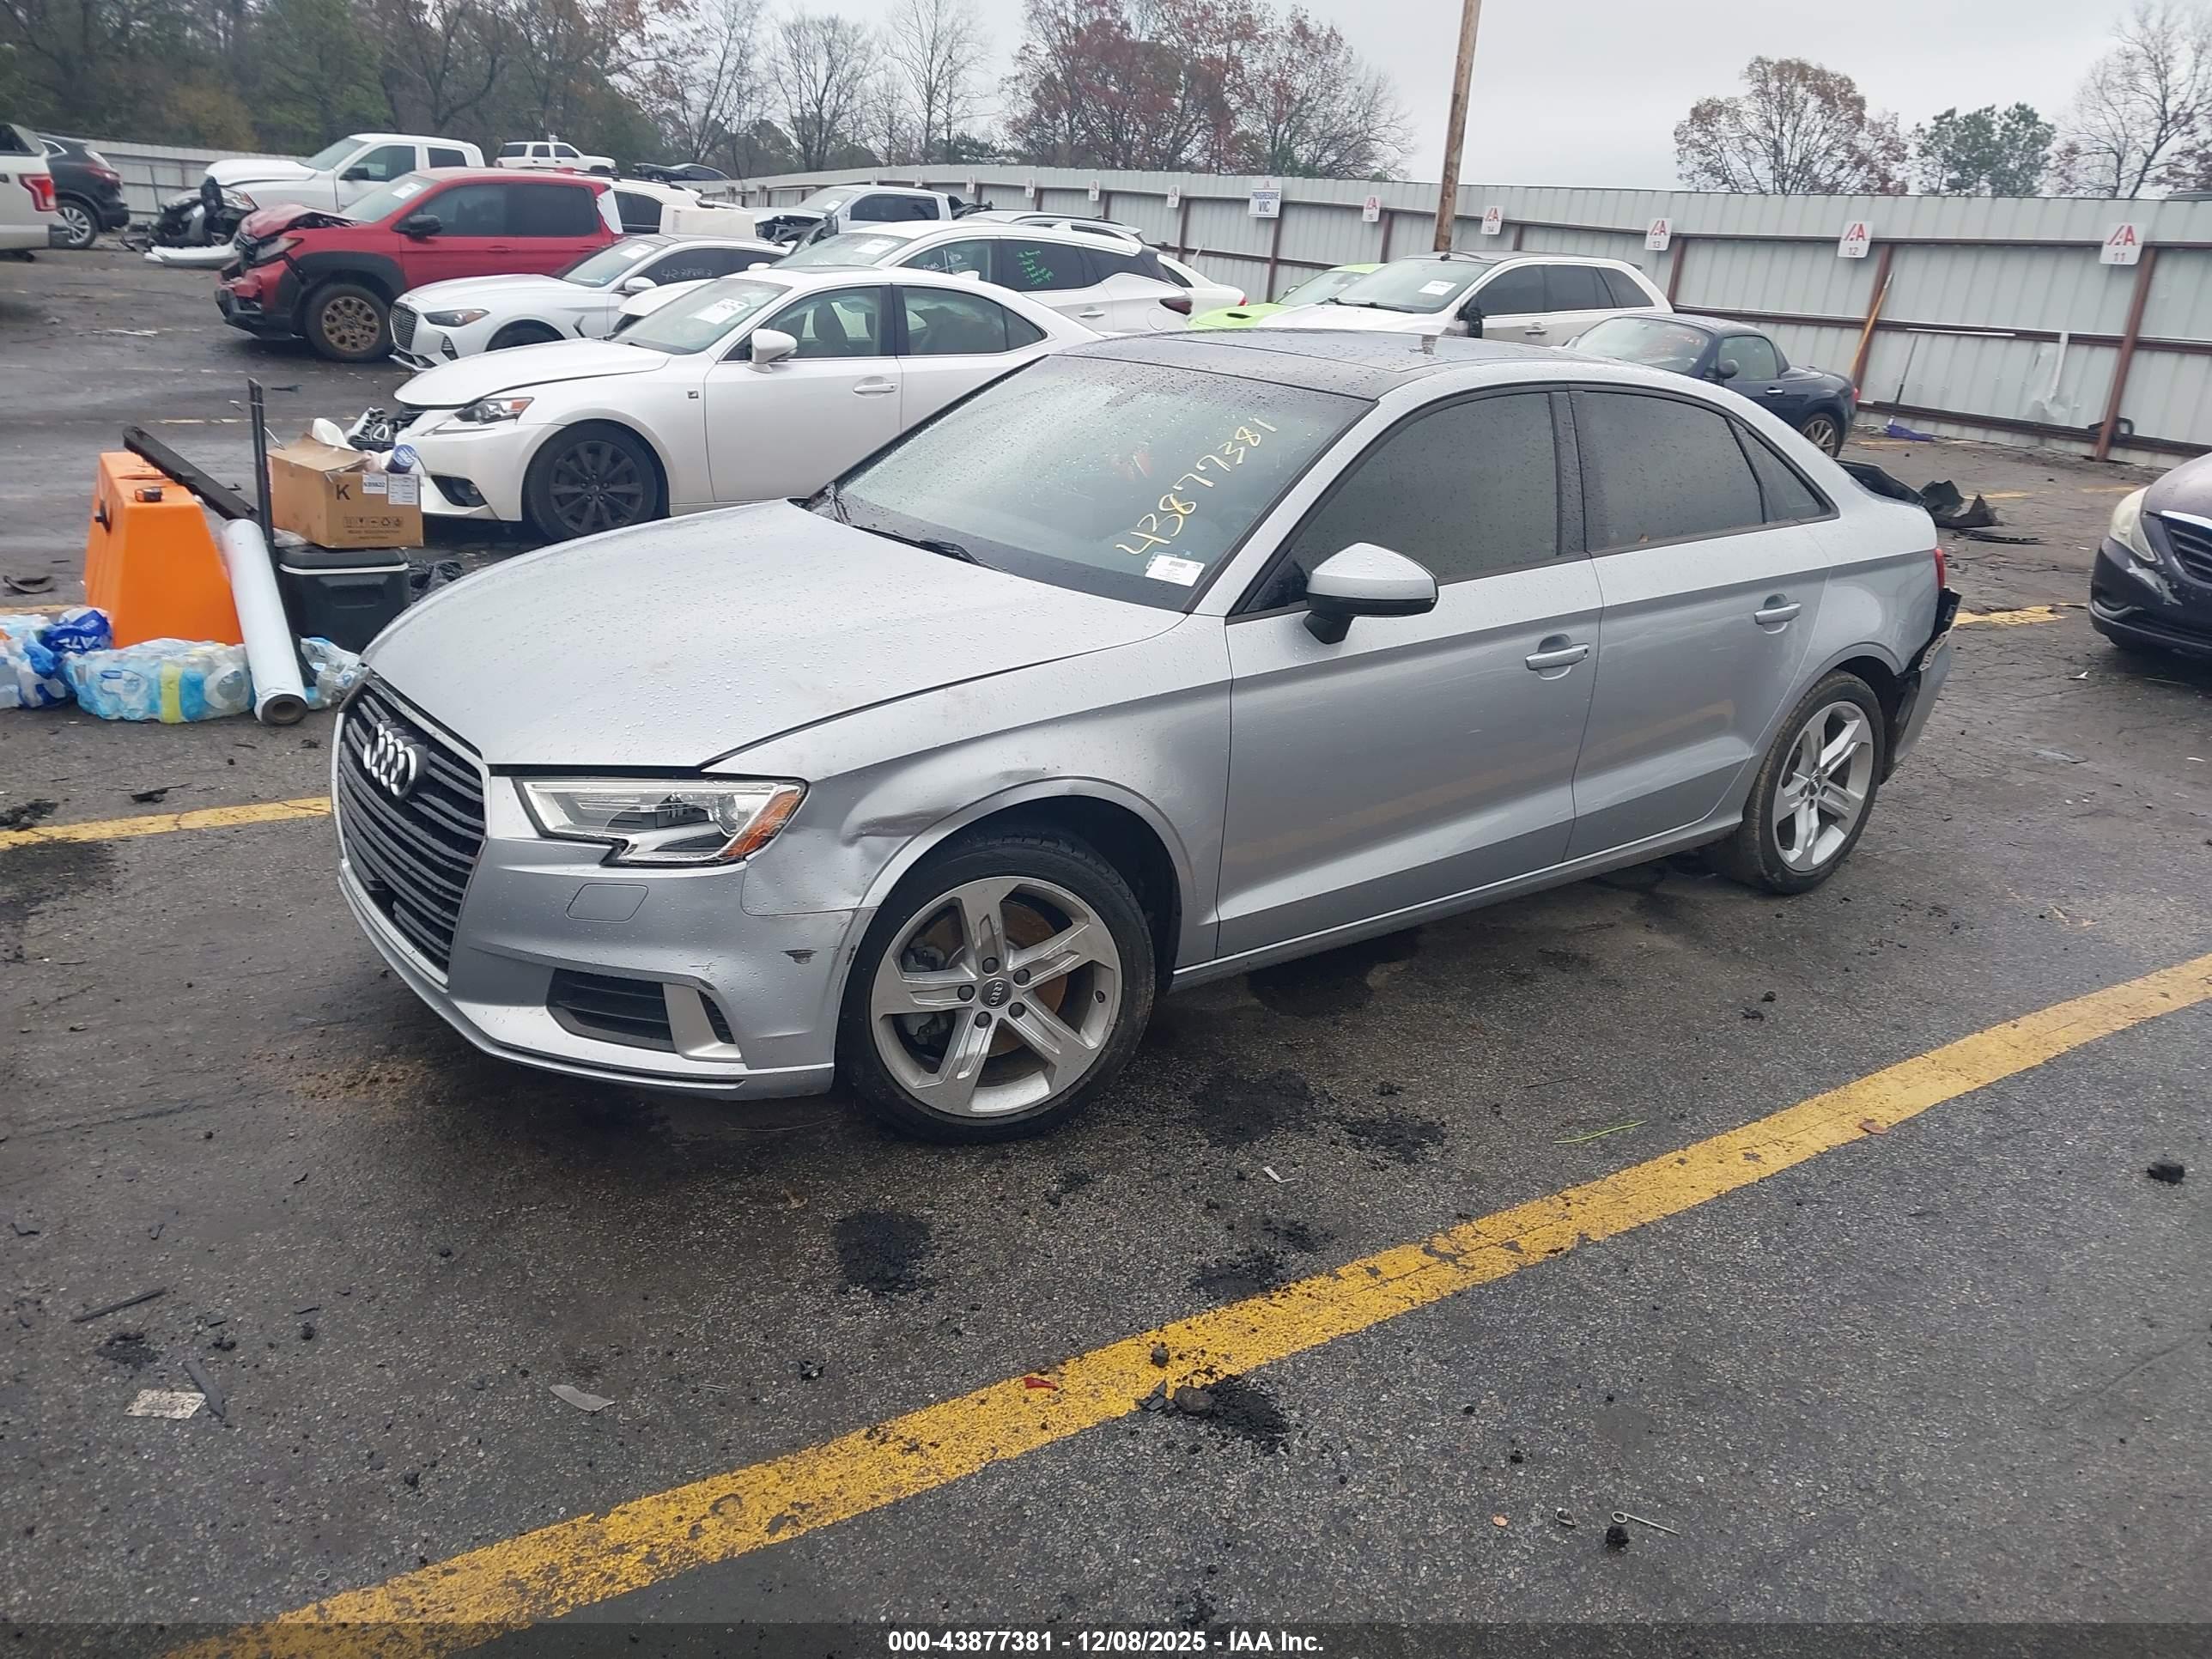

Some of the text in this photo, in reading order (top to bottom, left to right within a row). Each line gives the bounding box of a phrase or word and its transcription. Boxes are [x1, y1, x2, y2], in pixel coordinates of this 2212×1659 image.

[1848, 246, 1859, 256] 12
[2113, 252, 2126, 262] 11
[336, 483, 351, 501] K
[1115, 417, 1279, 555] 43877381
